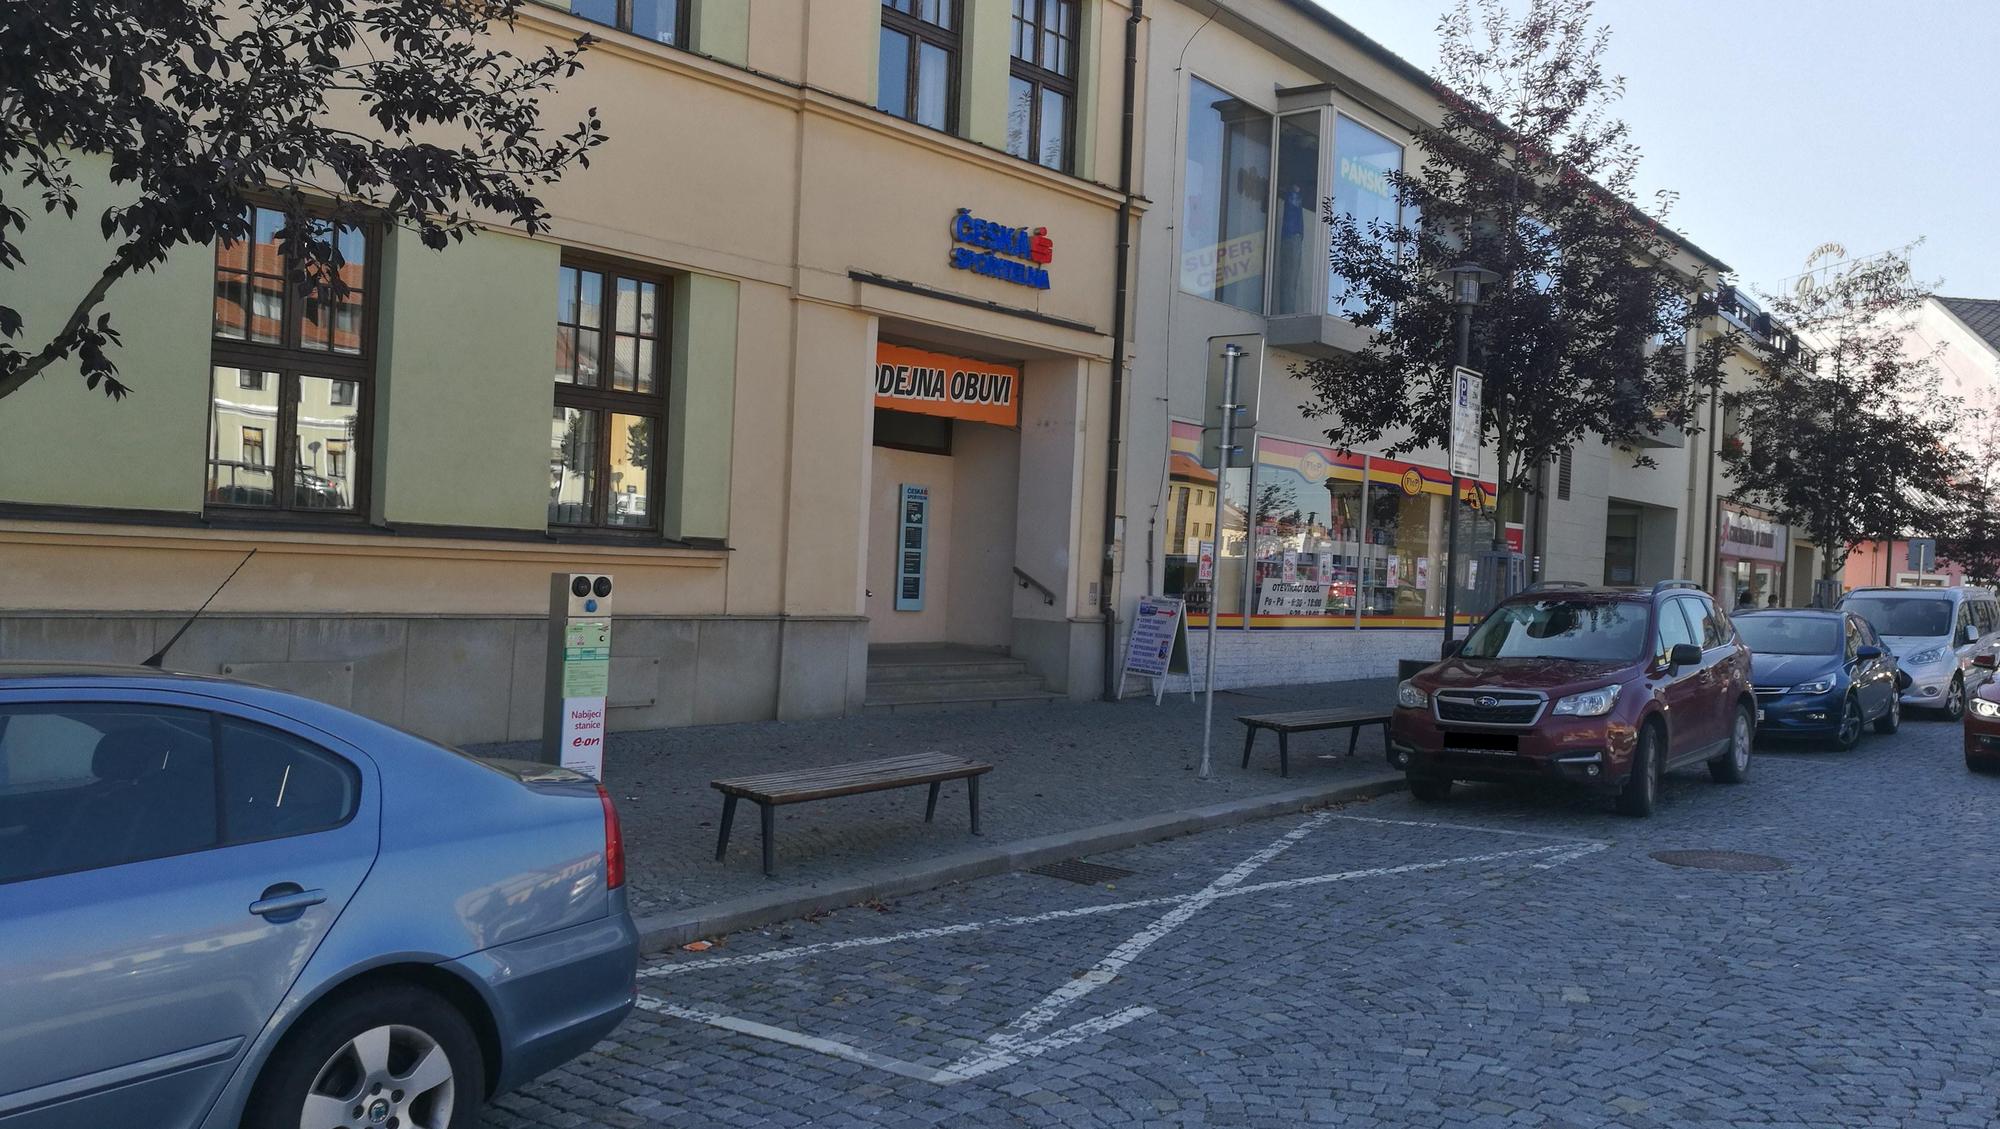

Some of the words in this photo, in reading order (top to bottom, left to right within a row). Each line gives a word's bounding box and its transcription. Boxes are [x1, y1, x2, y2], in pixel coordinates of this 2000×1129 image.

[951, 207, 1031, 260] ČESKÁ
[1185, 241, 1253, 272] SUPER
[1197, 259, 1250, 287] CENY
[875, 364, 946, 399] DEJNA
[951, 371, 1012, 403] OBUVI
[575, 721, 601, 730] stanice
